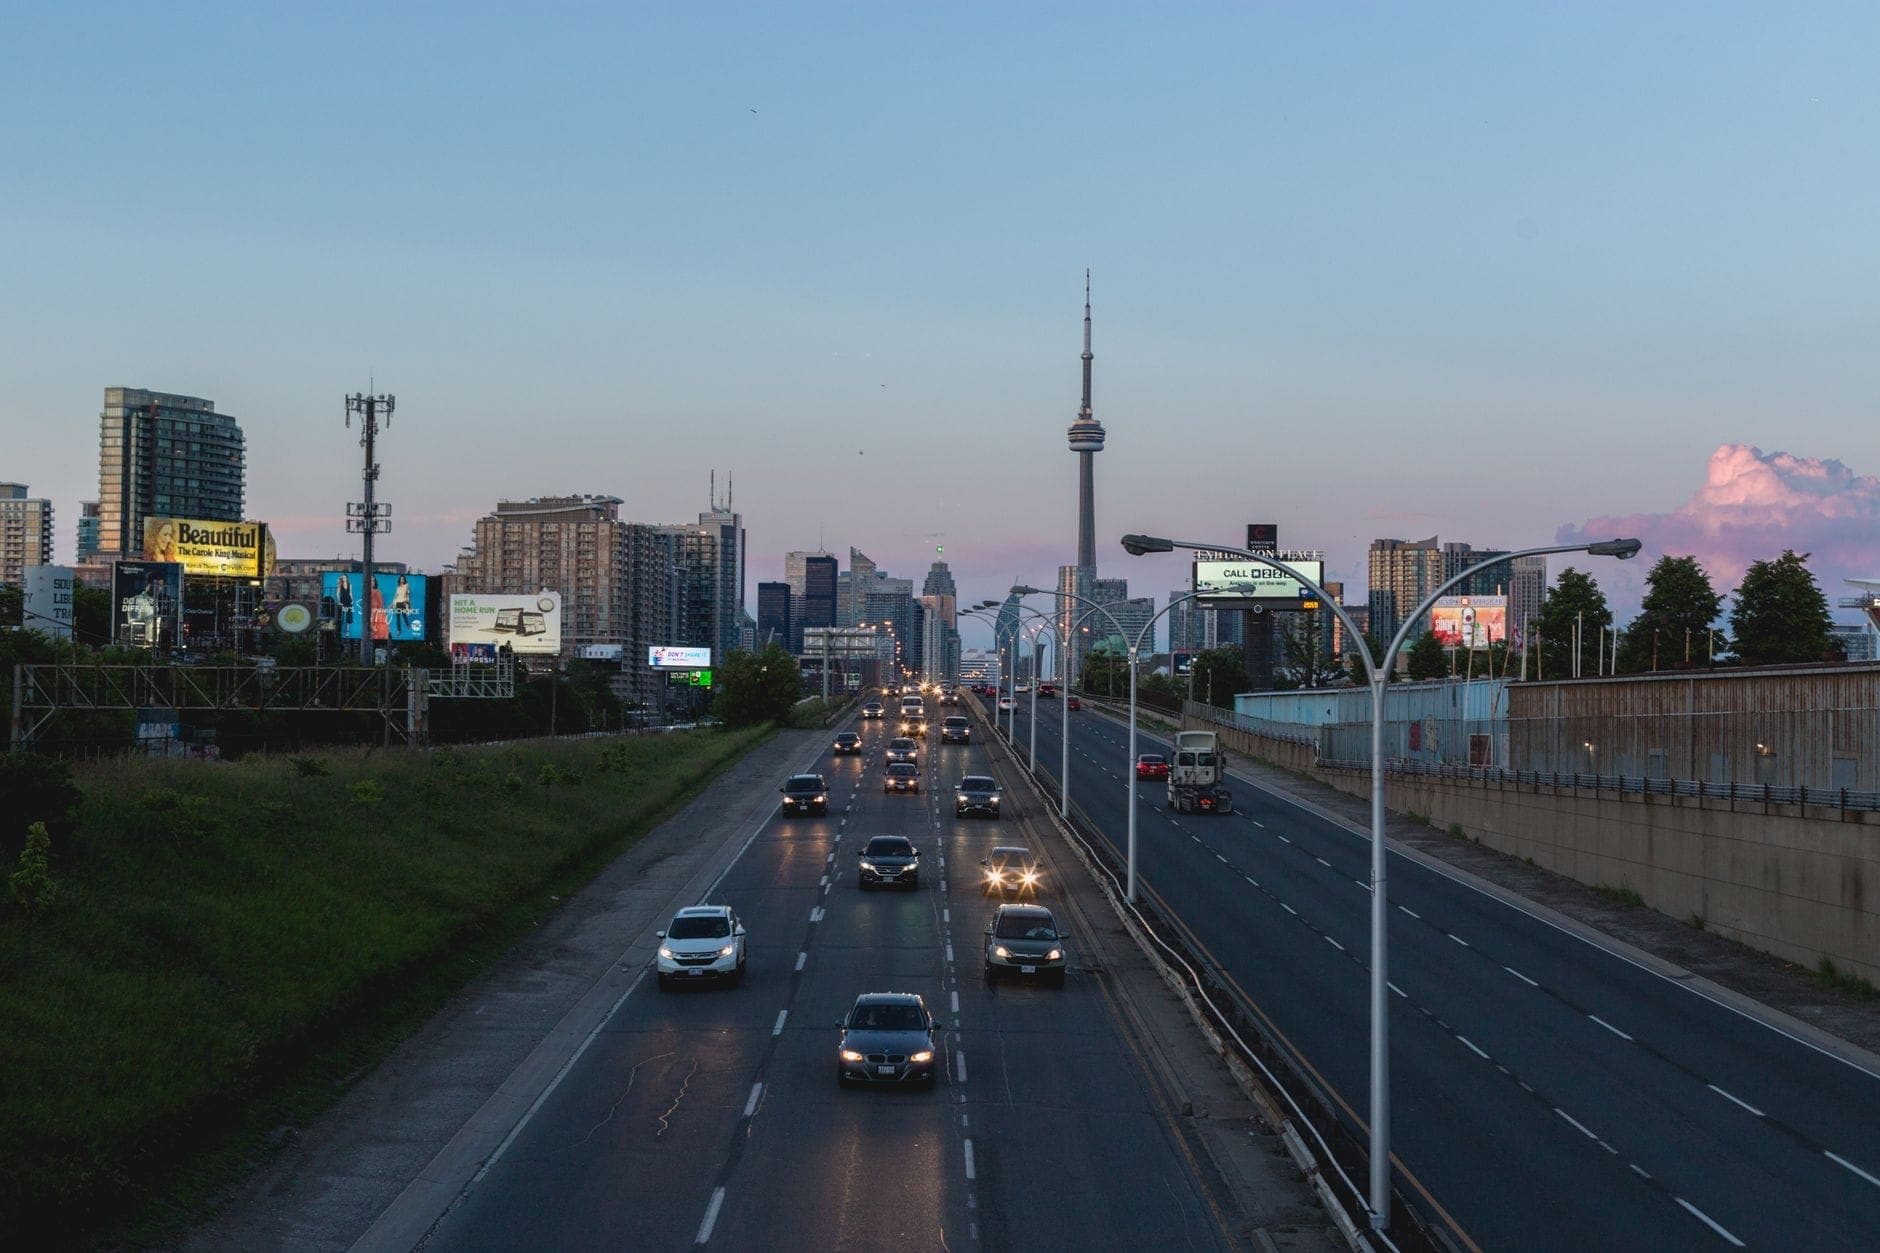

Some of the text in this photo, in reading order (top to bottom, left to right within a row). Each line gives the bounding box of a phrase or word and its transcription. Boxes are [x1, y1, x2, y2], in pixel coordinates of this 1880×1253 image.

[178, 523, 256, 547] Beautiful
[178, 547, 256, 560] The Carole King Musical
[1223, 569, 1249, 578] CALL
